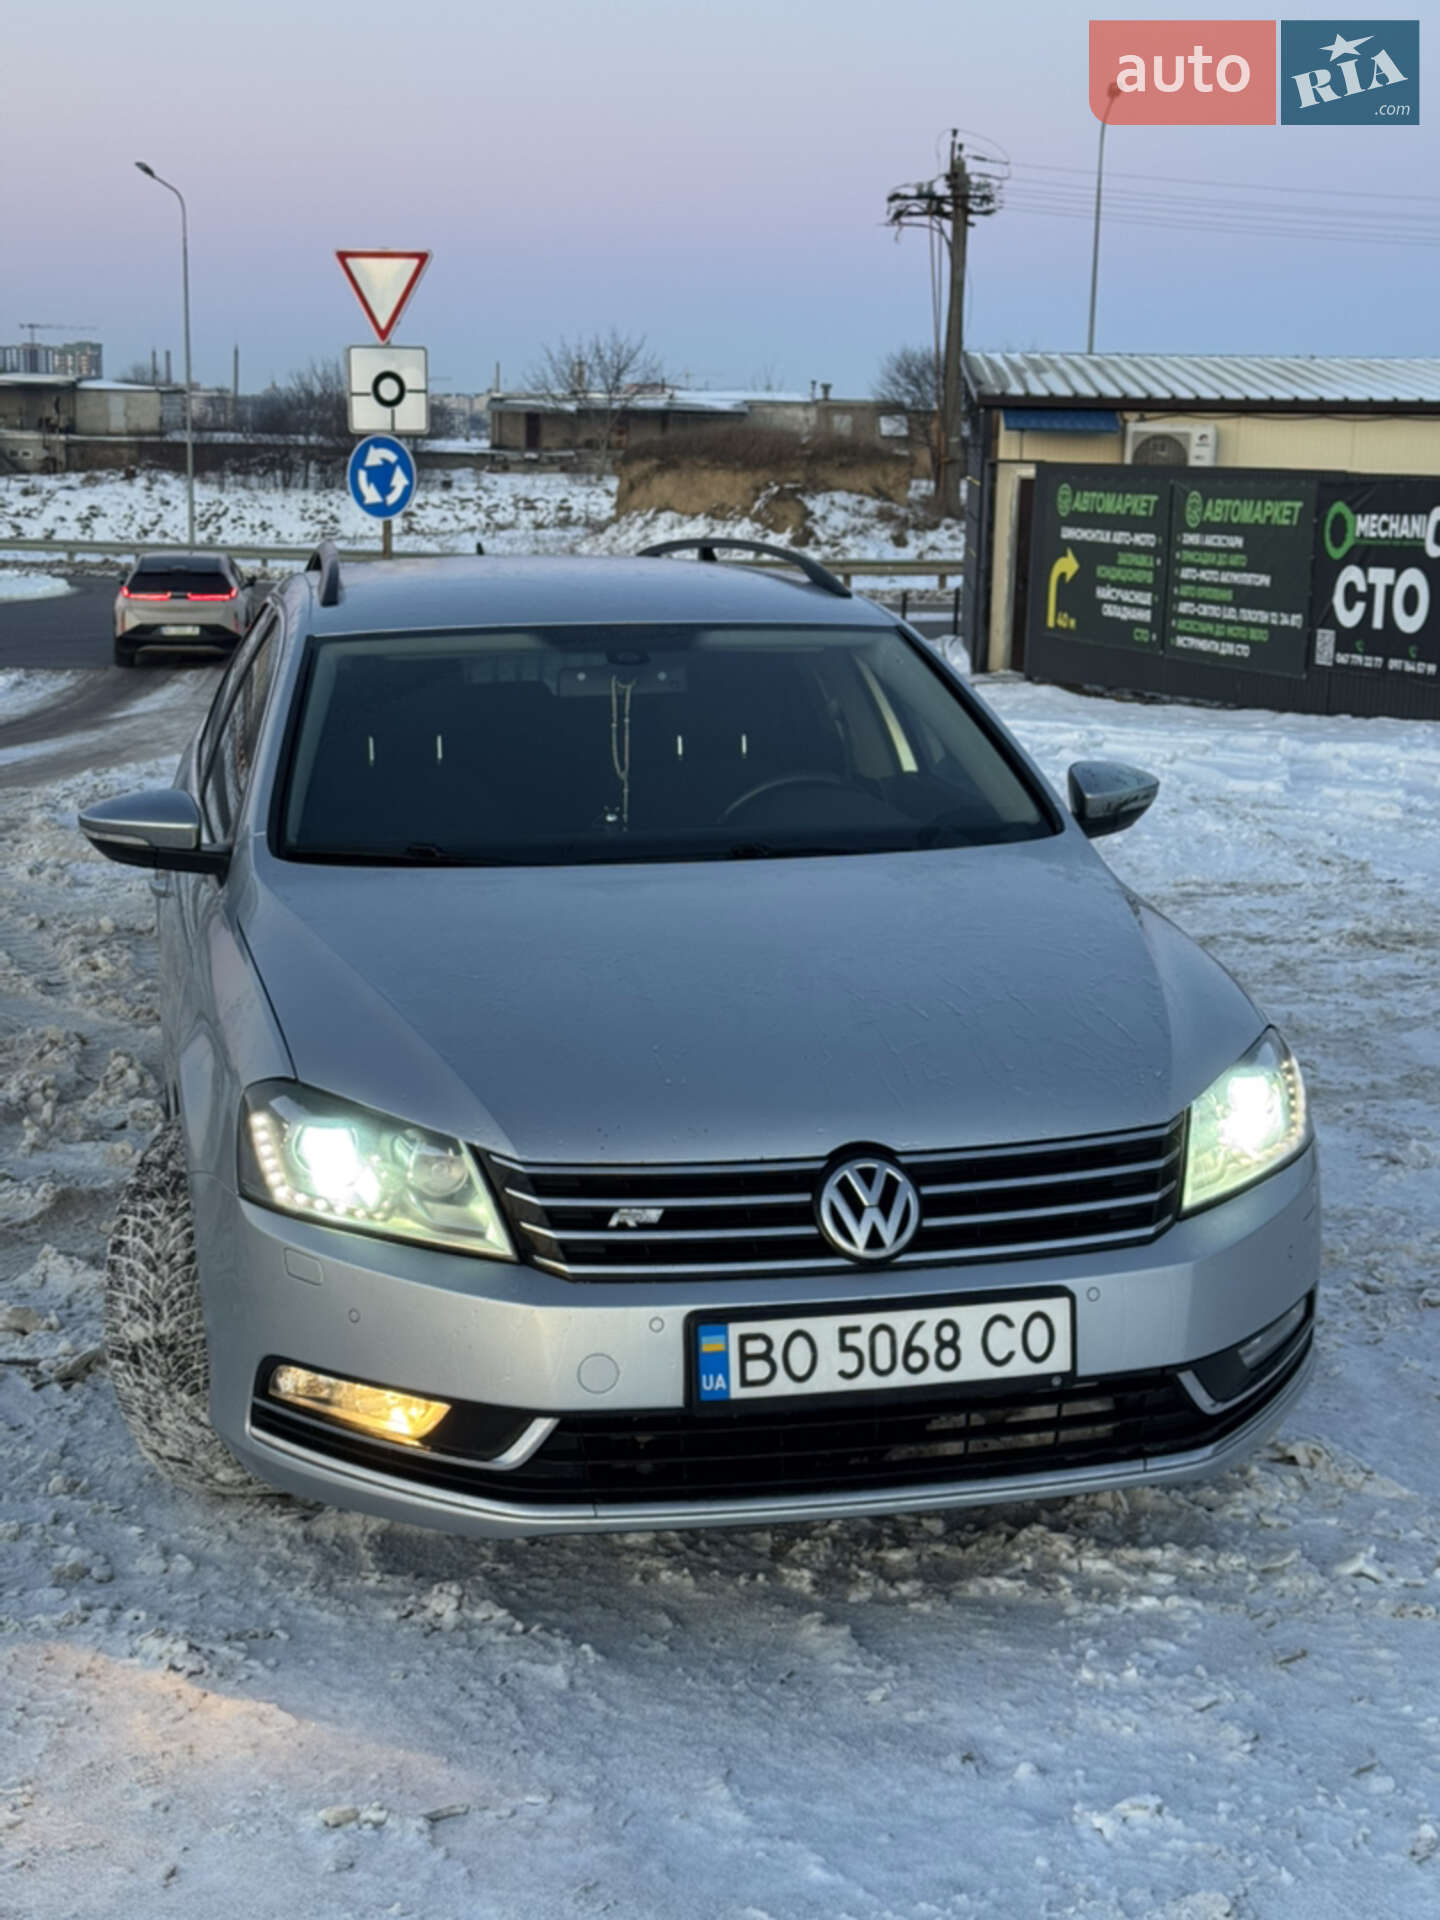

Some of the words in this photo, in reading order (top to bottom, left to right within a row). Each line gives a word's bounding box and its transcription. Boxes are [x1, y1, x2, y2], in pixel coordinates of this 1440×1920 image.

[1071, 491, 1159, 517] АВТОМАРКЕТ
[1203, 498, 1303, 526] АВТОМАРКЕТ
[1332, 564, 1430, 634] СТО
[737, 1328, 818, 1389] BO
[837, 1317, 962, 1380] 5068
[981, 1309, 1056, 1368] CO
[702, 1373, 727, 1390] UA
